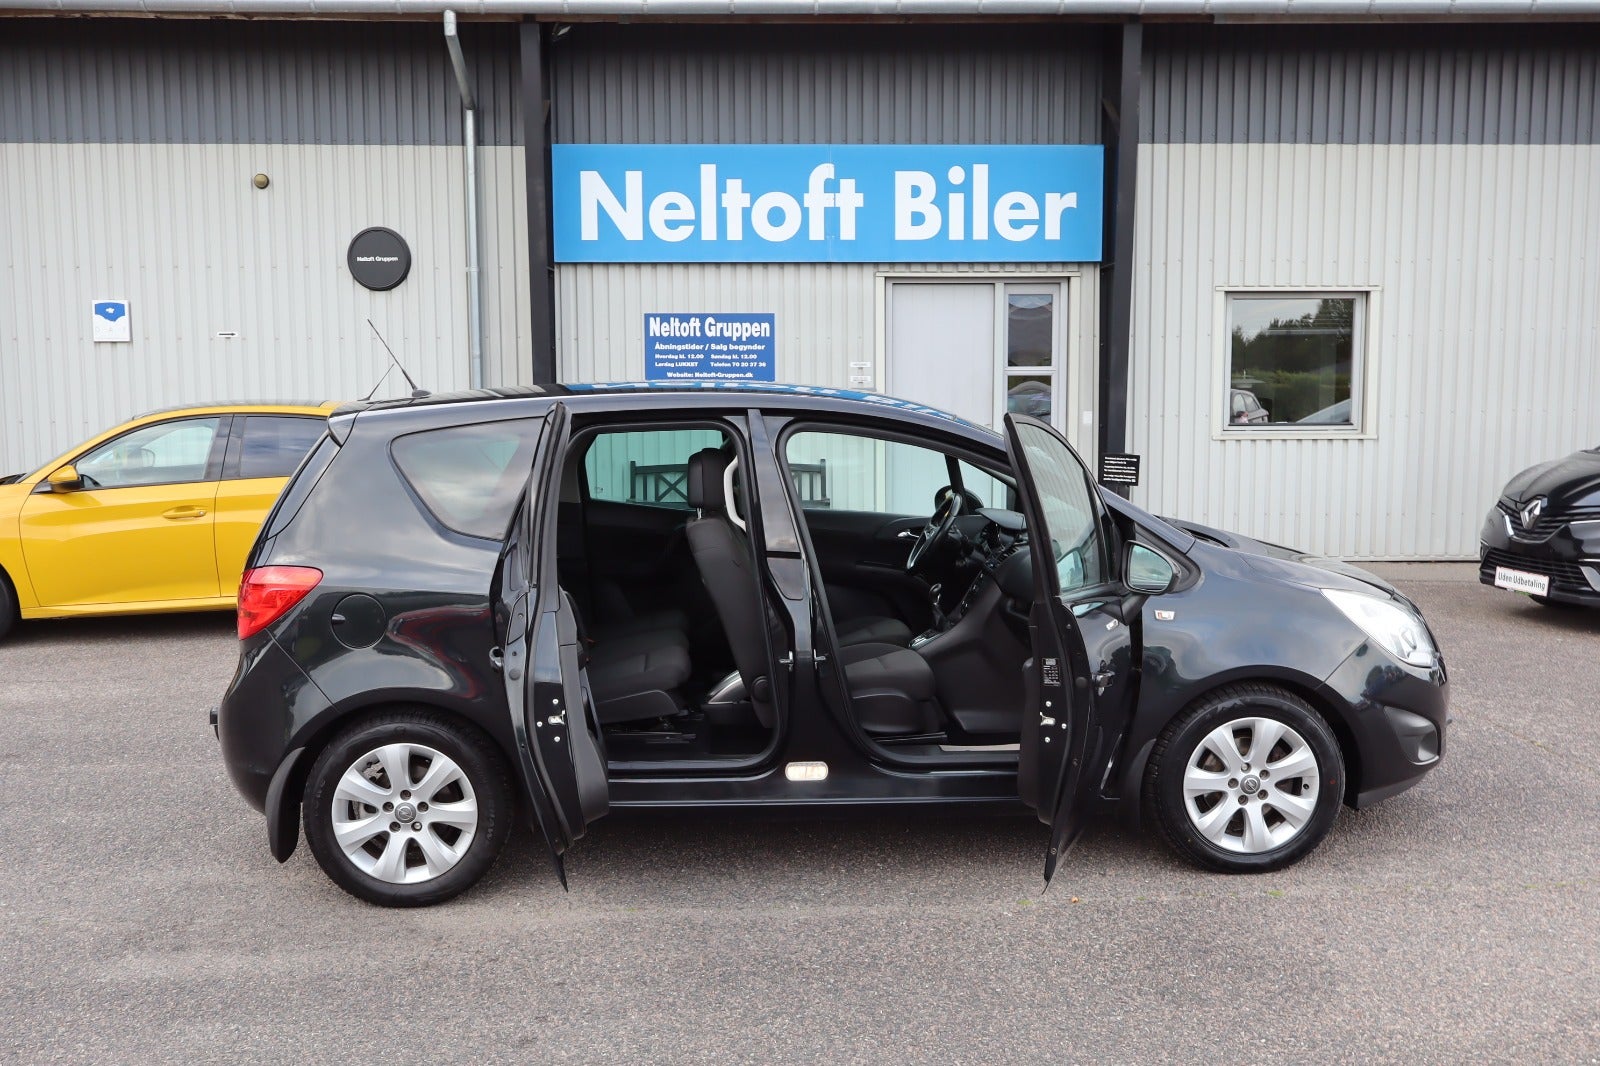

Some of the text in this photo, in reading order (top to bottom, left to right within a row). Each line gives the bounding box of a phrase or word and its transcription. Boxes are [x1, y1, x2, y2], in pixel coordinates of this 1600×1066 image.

[580, 163, 1077, 242] Neltoft Biler
[649, 317, 770, 341] Neltoft Gruppen
[655, 341, 704, 351] Åbningstider
[1498, 571, 1546, 591] Uden Udbetaling
